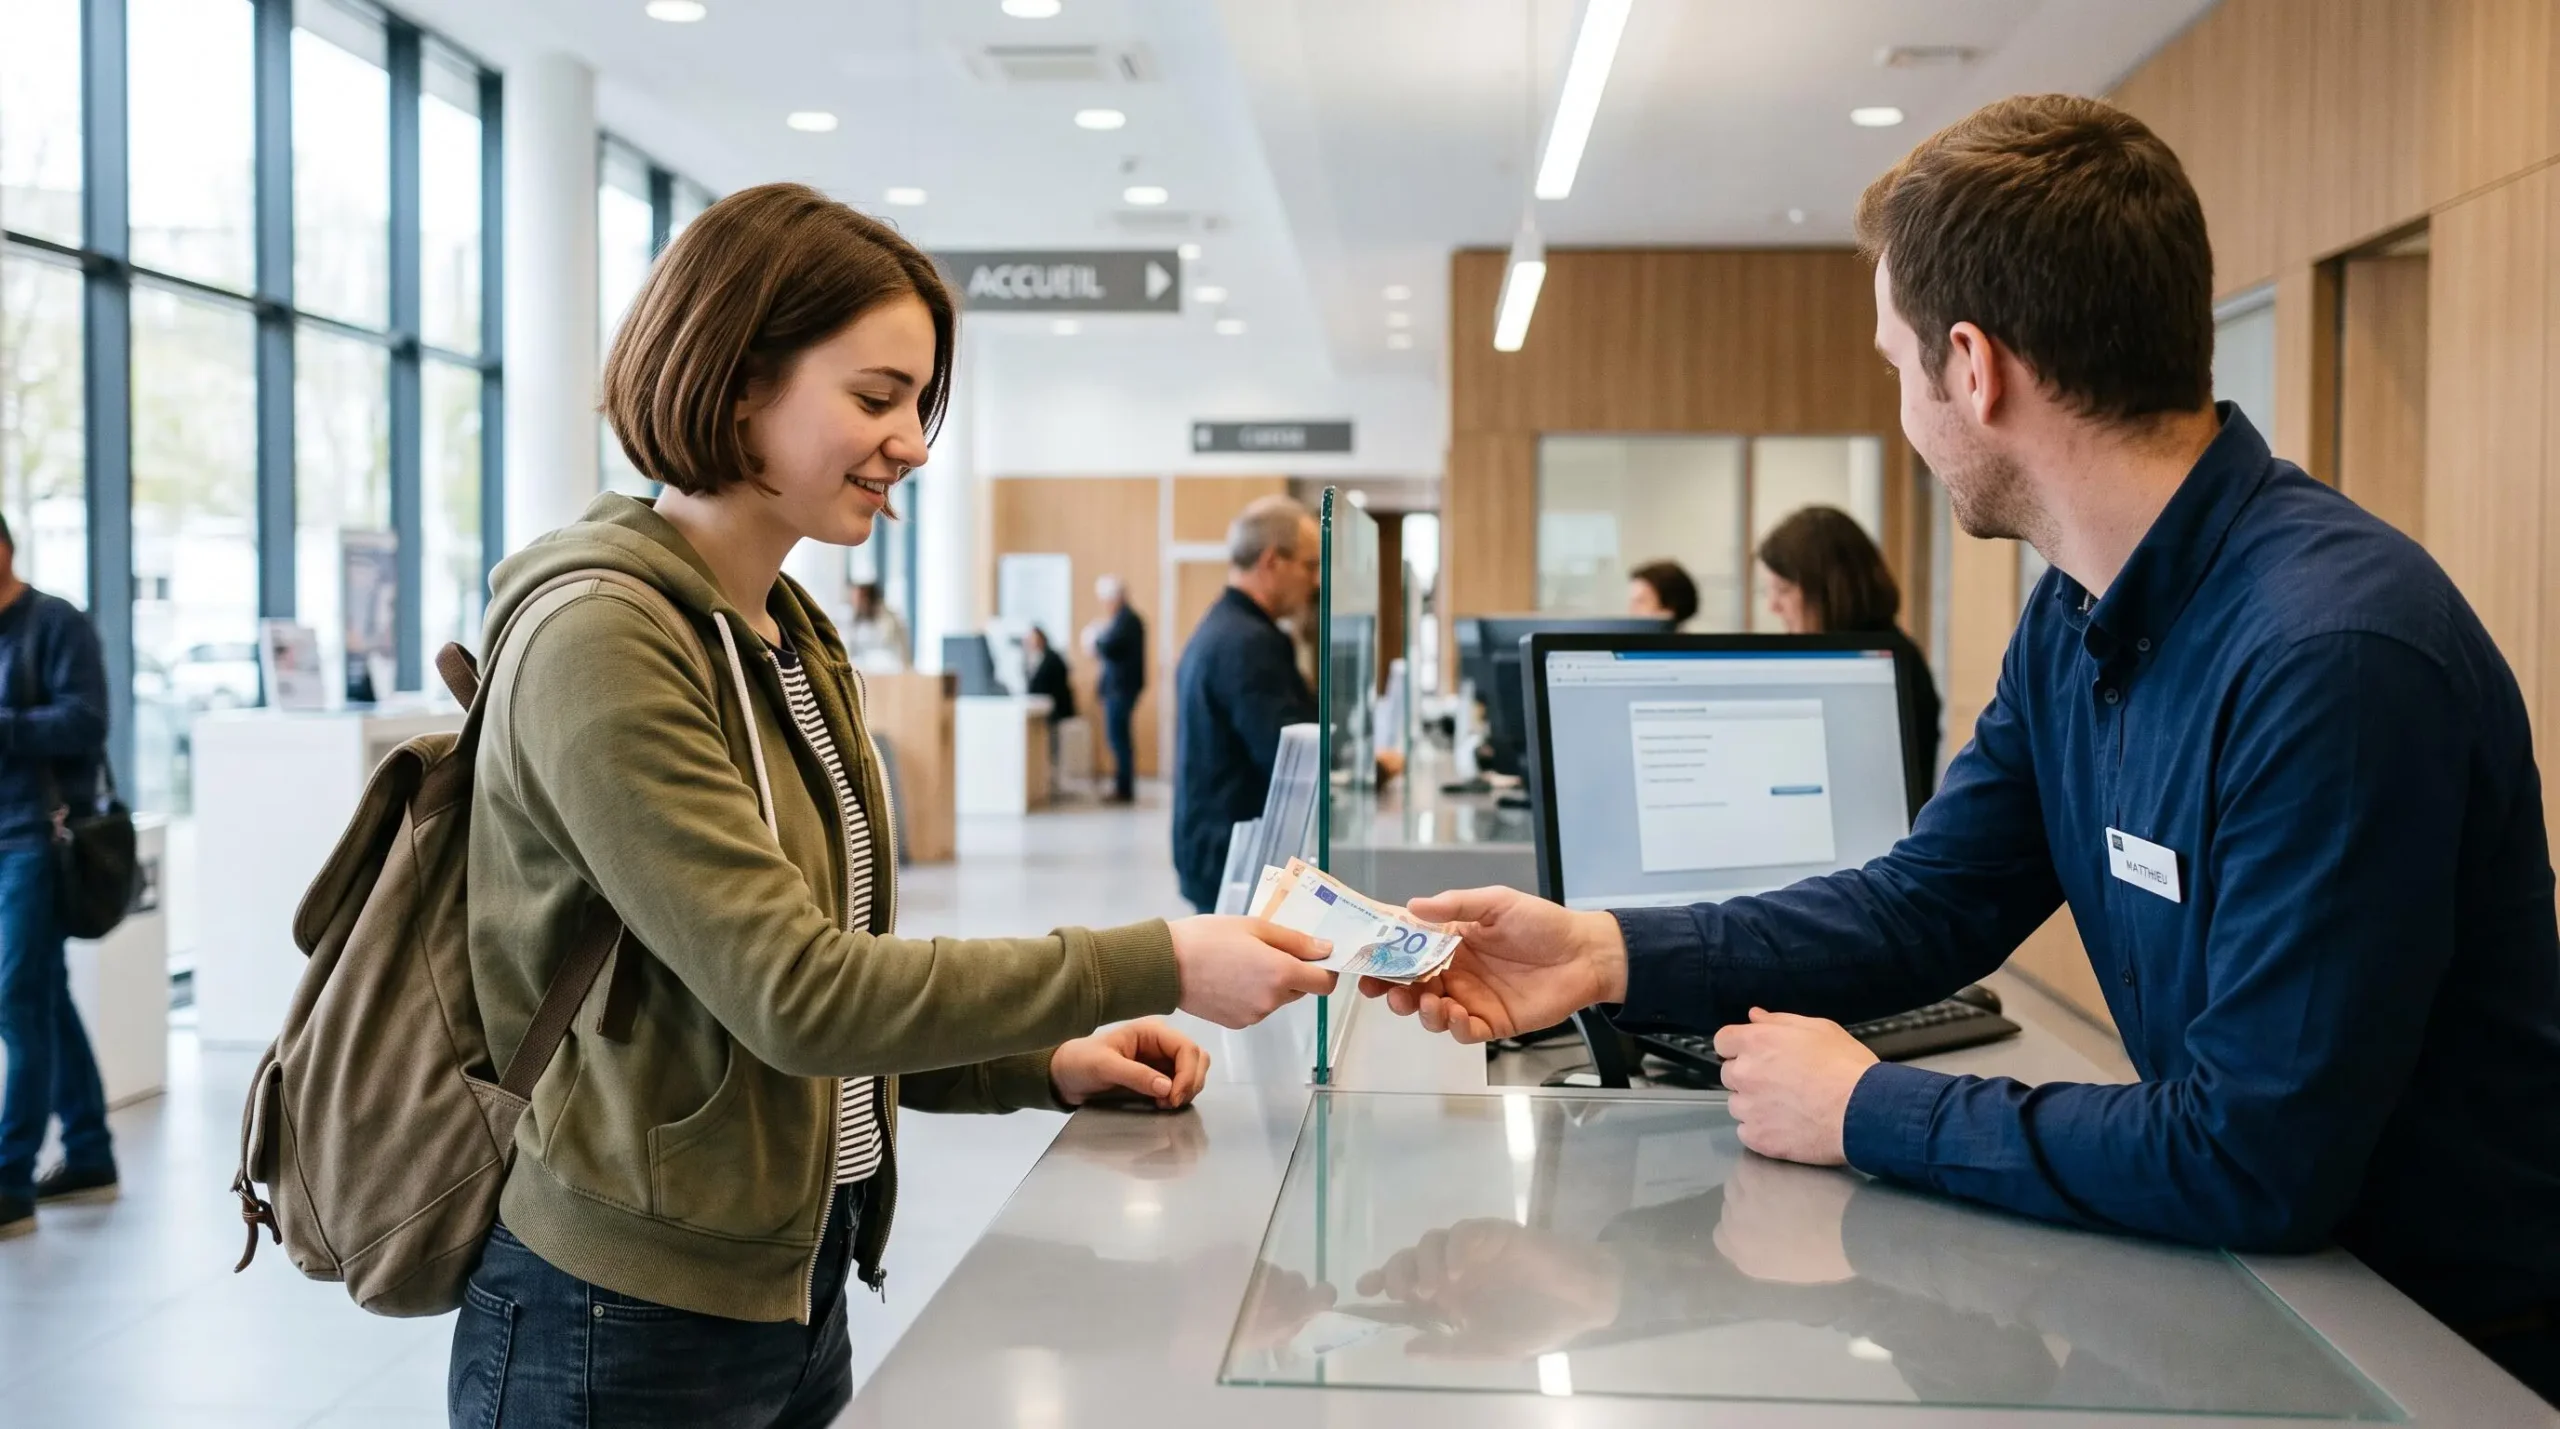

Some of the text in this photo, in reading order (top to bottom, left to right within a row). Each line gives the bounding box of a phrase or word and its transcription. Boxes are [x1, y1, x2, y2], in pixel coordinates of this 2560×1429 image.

[968, 264, 1106, 299] ACCUEIL
[2126, 860, 2168, 885] MATTHIEU
[1385, 926, 1427, 954] 20
